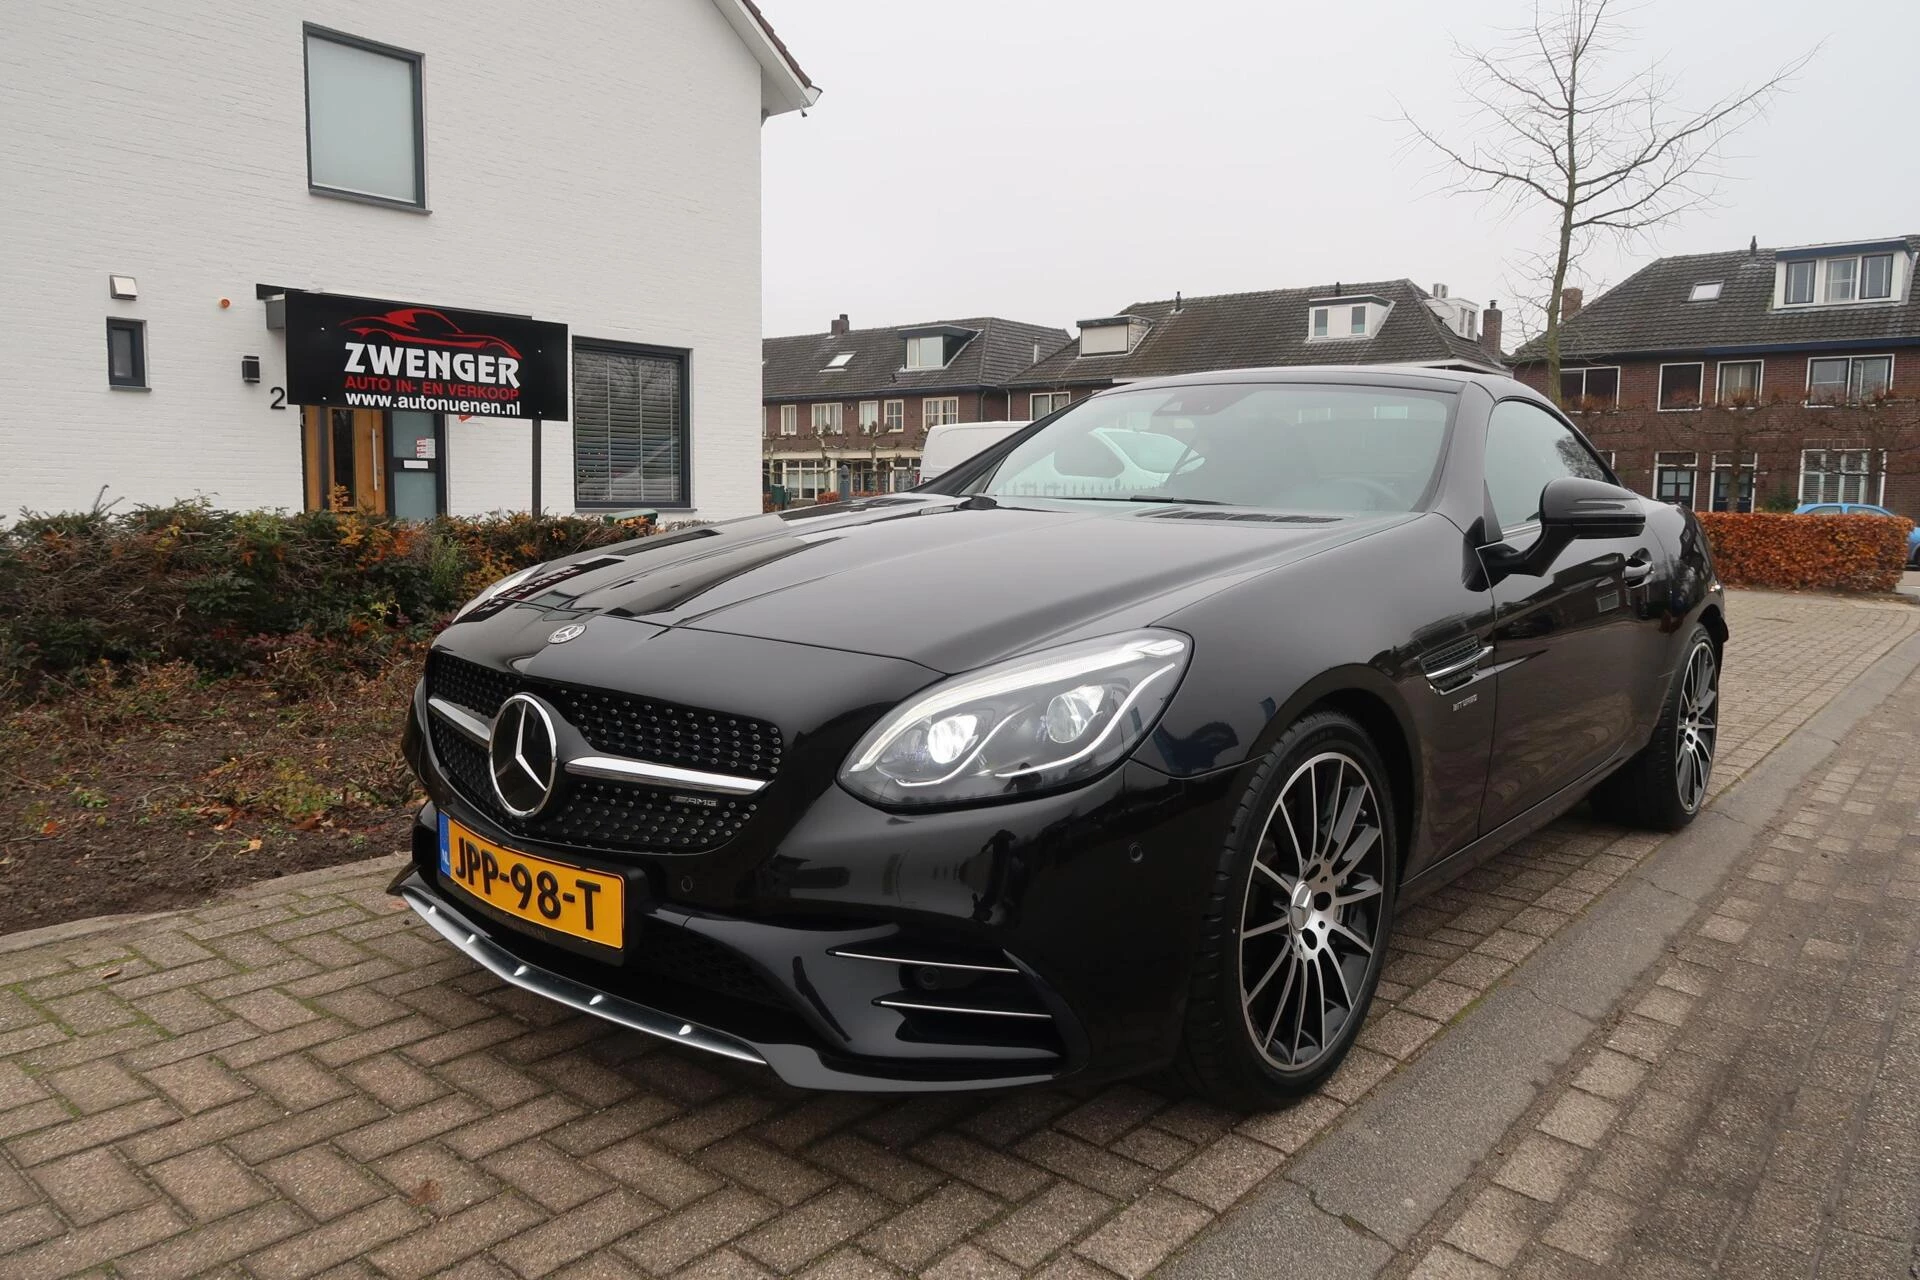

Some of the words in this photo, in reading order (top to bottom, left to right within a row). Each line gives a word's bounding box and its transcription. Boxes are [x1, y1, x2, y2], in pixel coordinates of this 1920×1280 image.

[344, 342, 520, 389] ZWENGER
[270, 386, 286, 410] 2
[345, 375, 391, 391] AUTO
[396, 379, 418, 393] IN-
[422, 382, 443, 396] EN
[448, 383, 519, 401] VERKOOP
[345, 392, 520, 416] www.autonuenen.nl
[455, 836, 602, 931] JPP-98-T
